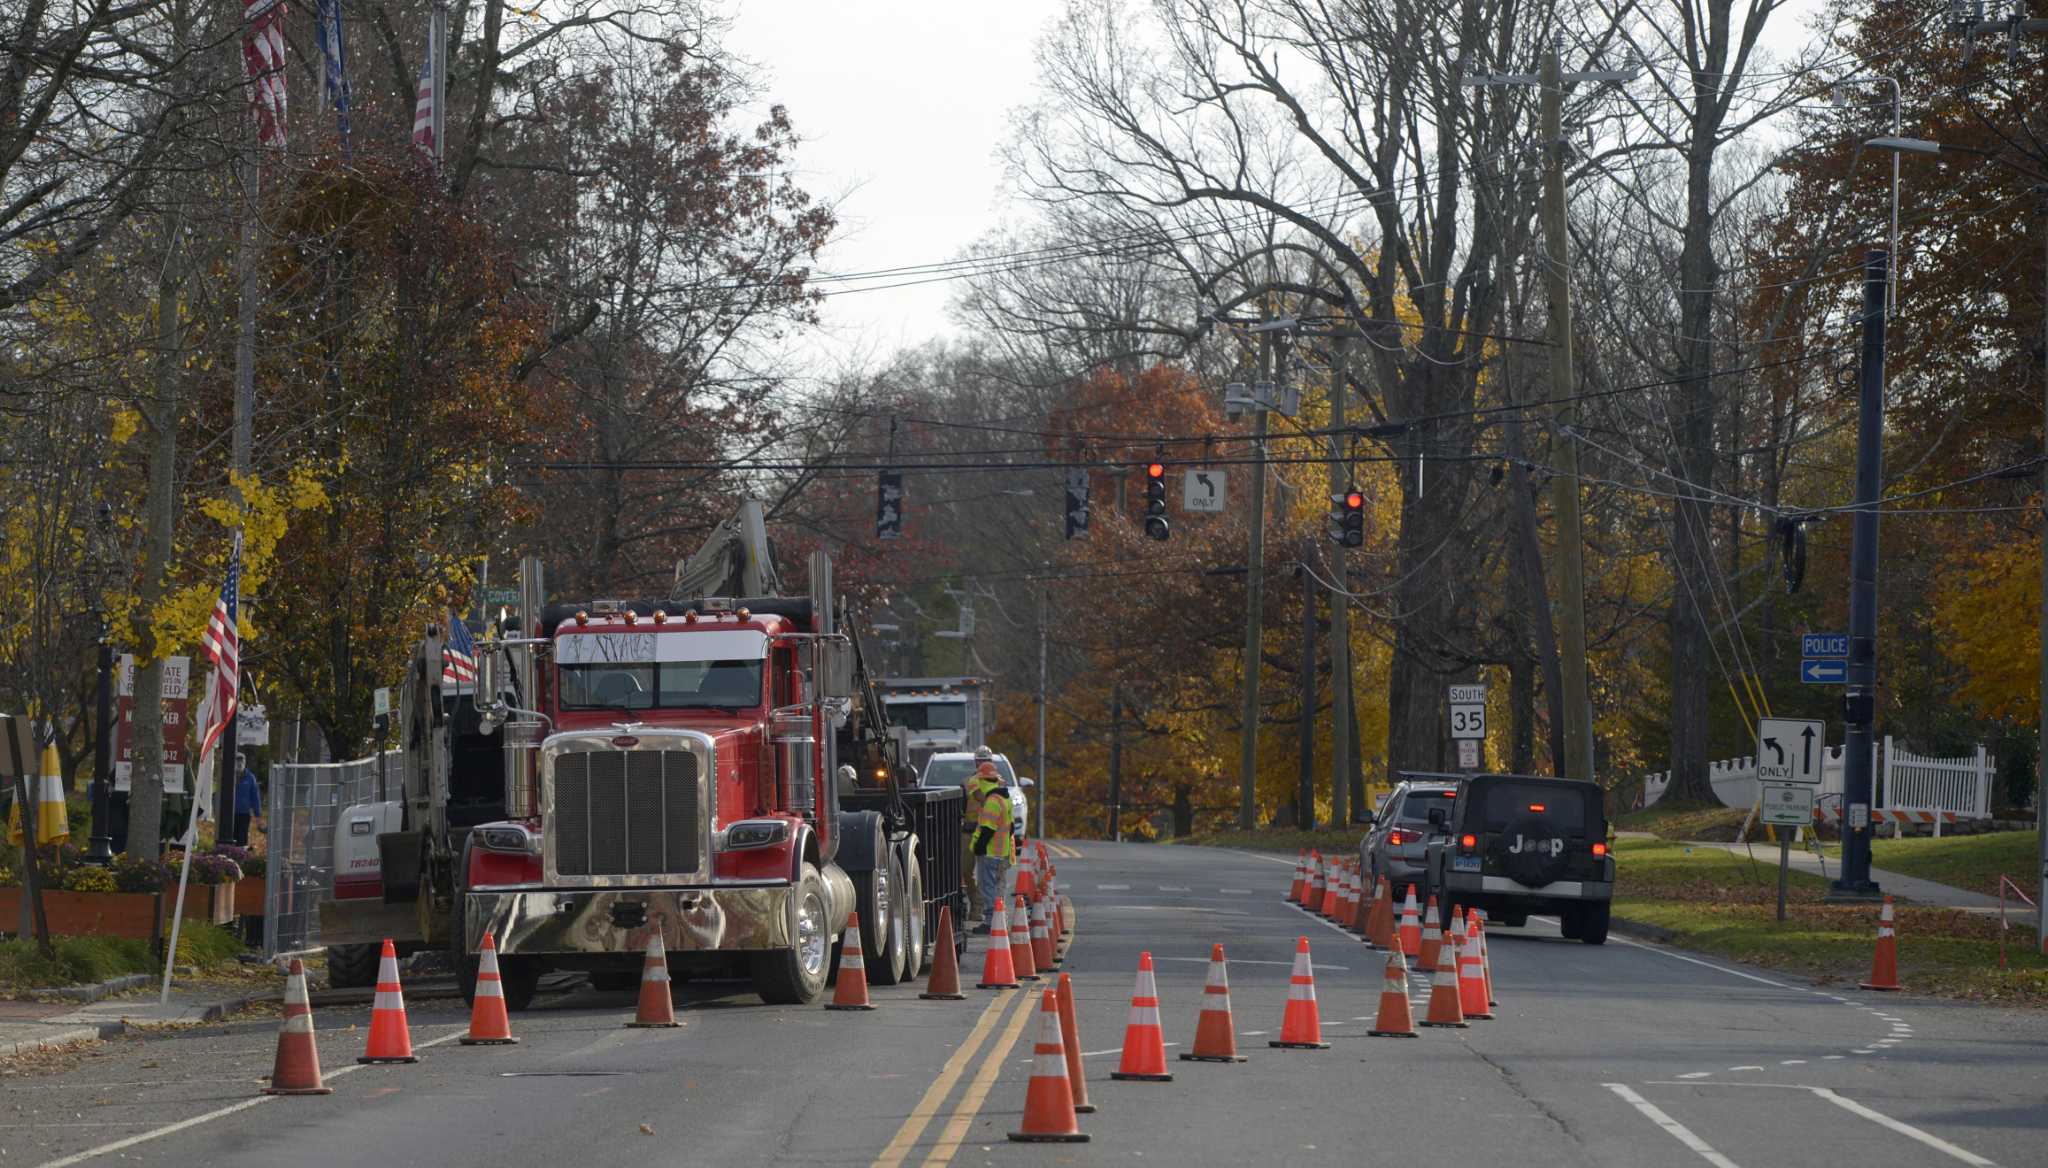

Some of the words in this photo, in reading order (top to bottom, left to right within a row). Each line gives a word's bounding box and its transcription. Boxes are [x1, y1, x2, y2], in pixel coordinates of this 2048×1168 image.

[1192, 498, 1216, 506] ONLY
[1805, 638, 1846, 653] POLICE
[1451, 688, 1484, 700] SOUTH
[1453, 711, 1482, 731] 35
[1760, 766, 1789, 777] ONLY
[1509, 834, 1563, 857] Jeep
